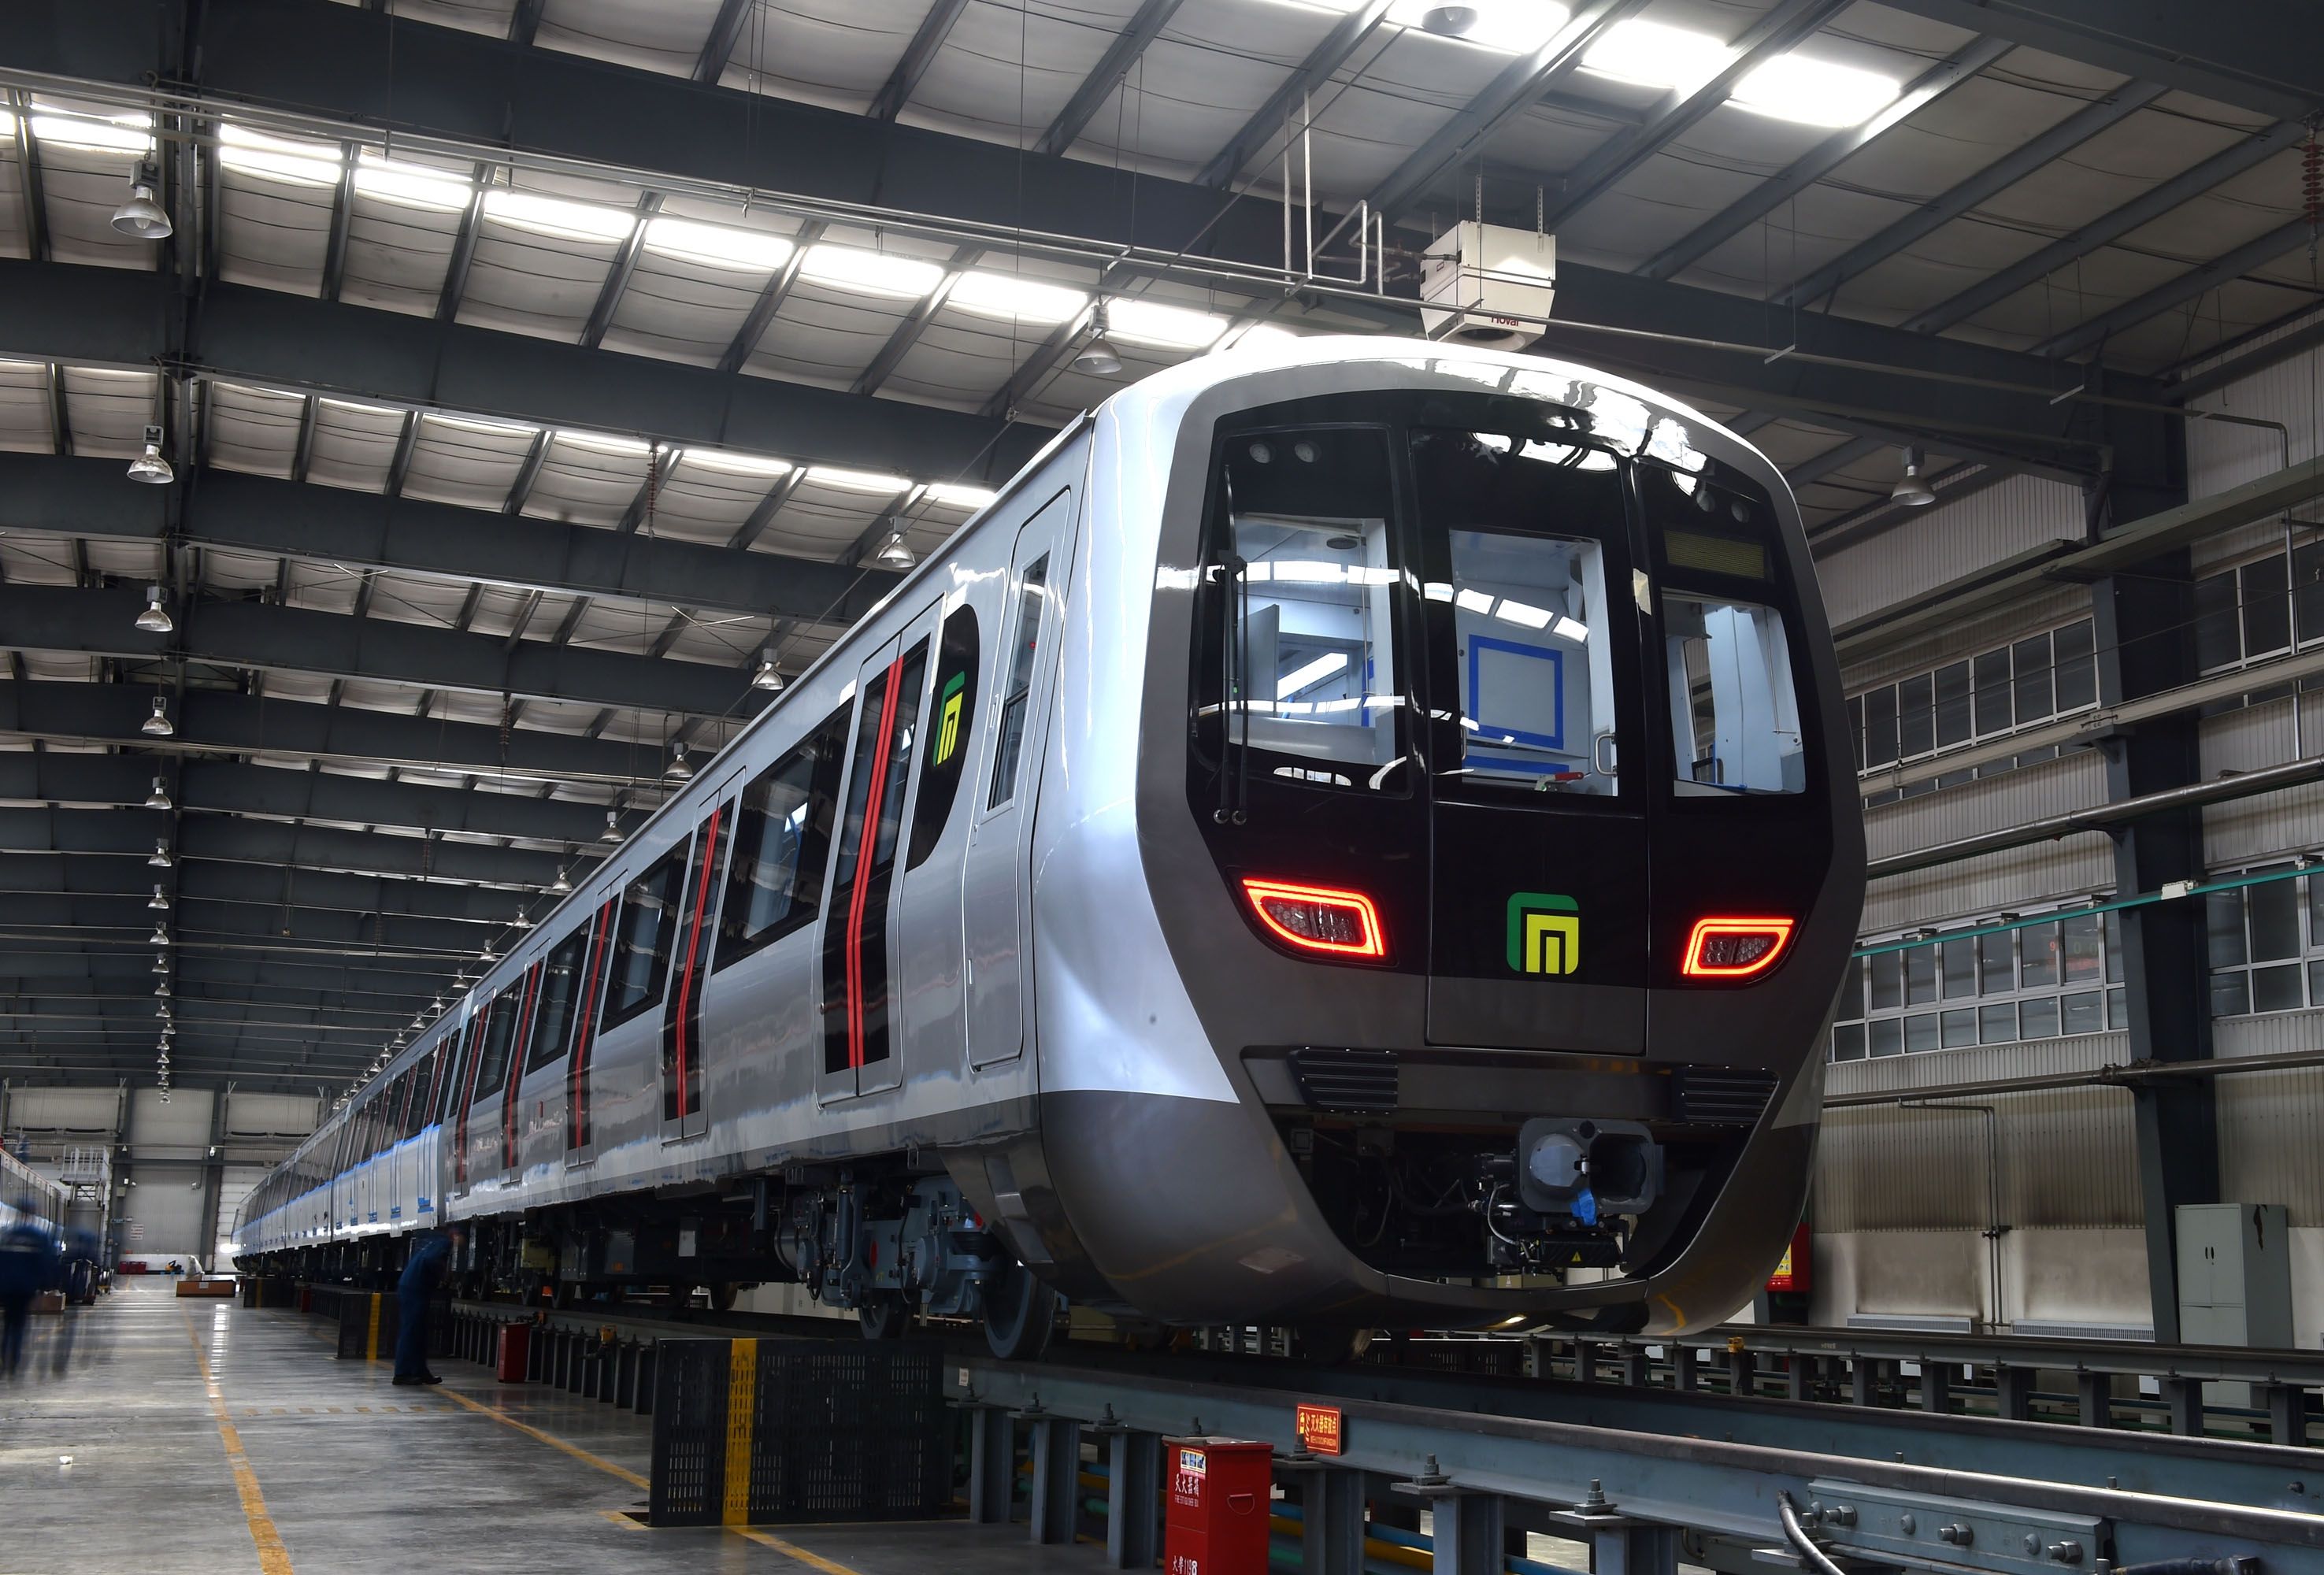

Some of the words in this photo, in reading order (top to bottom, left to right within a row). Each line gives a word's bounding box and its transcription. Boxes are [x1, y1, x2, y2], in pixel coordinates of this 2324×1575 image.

[1310, 1414, 1336, 1434] 灭火器存放点
